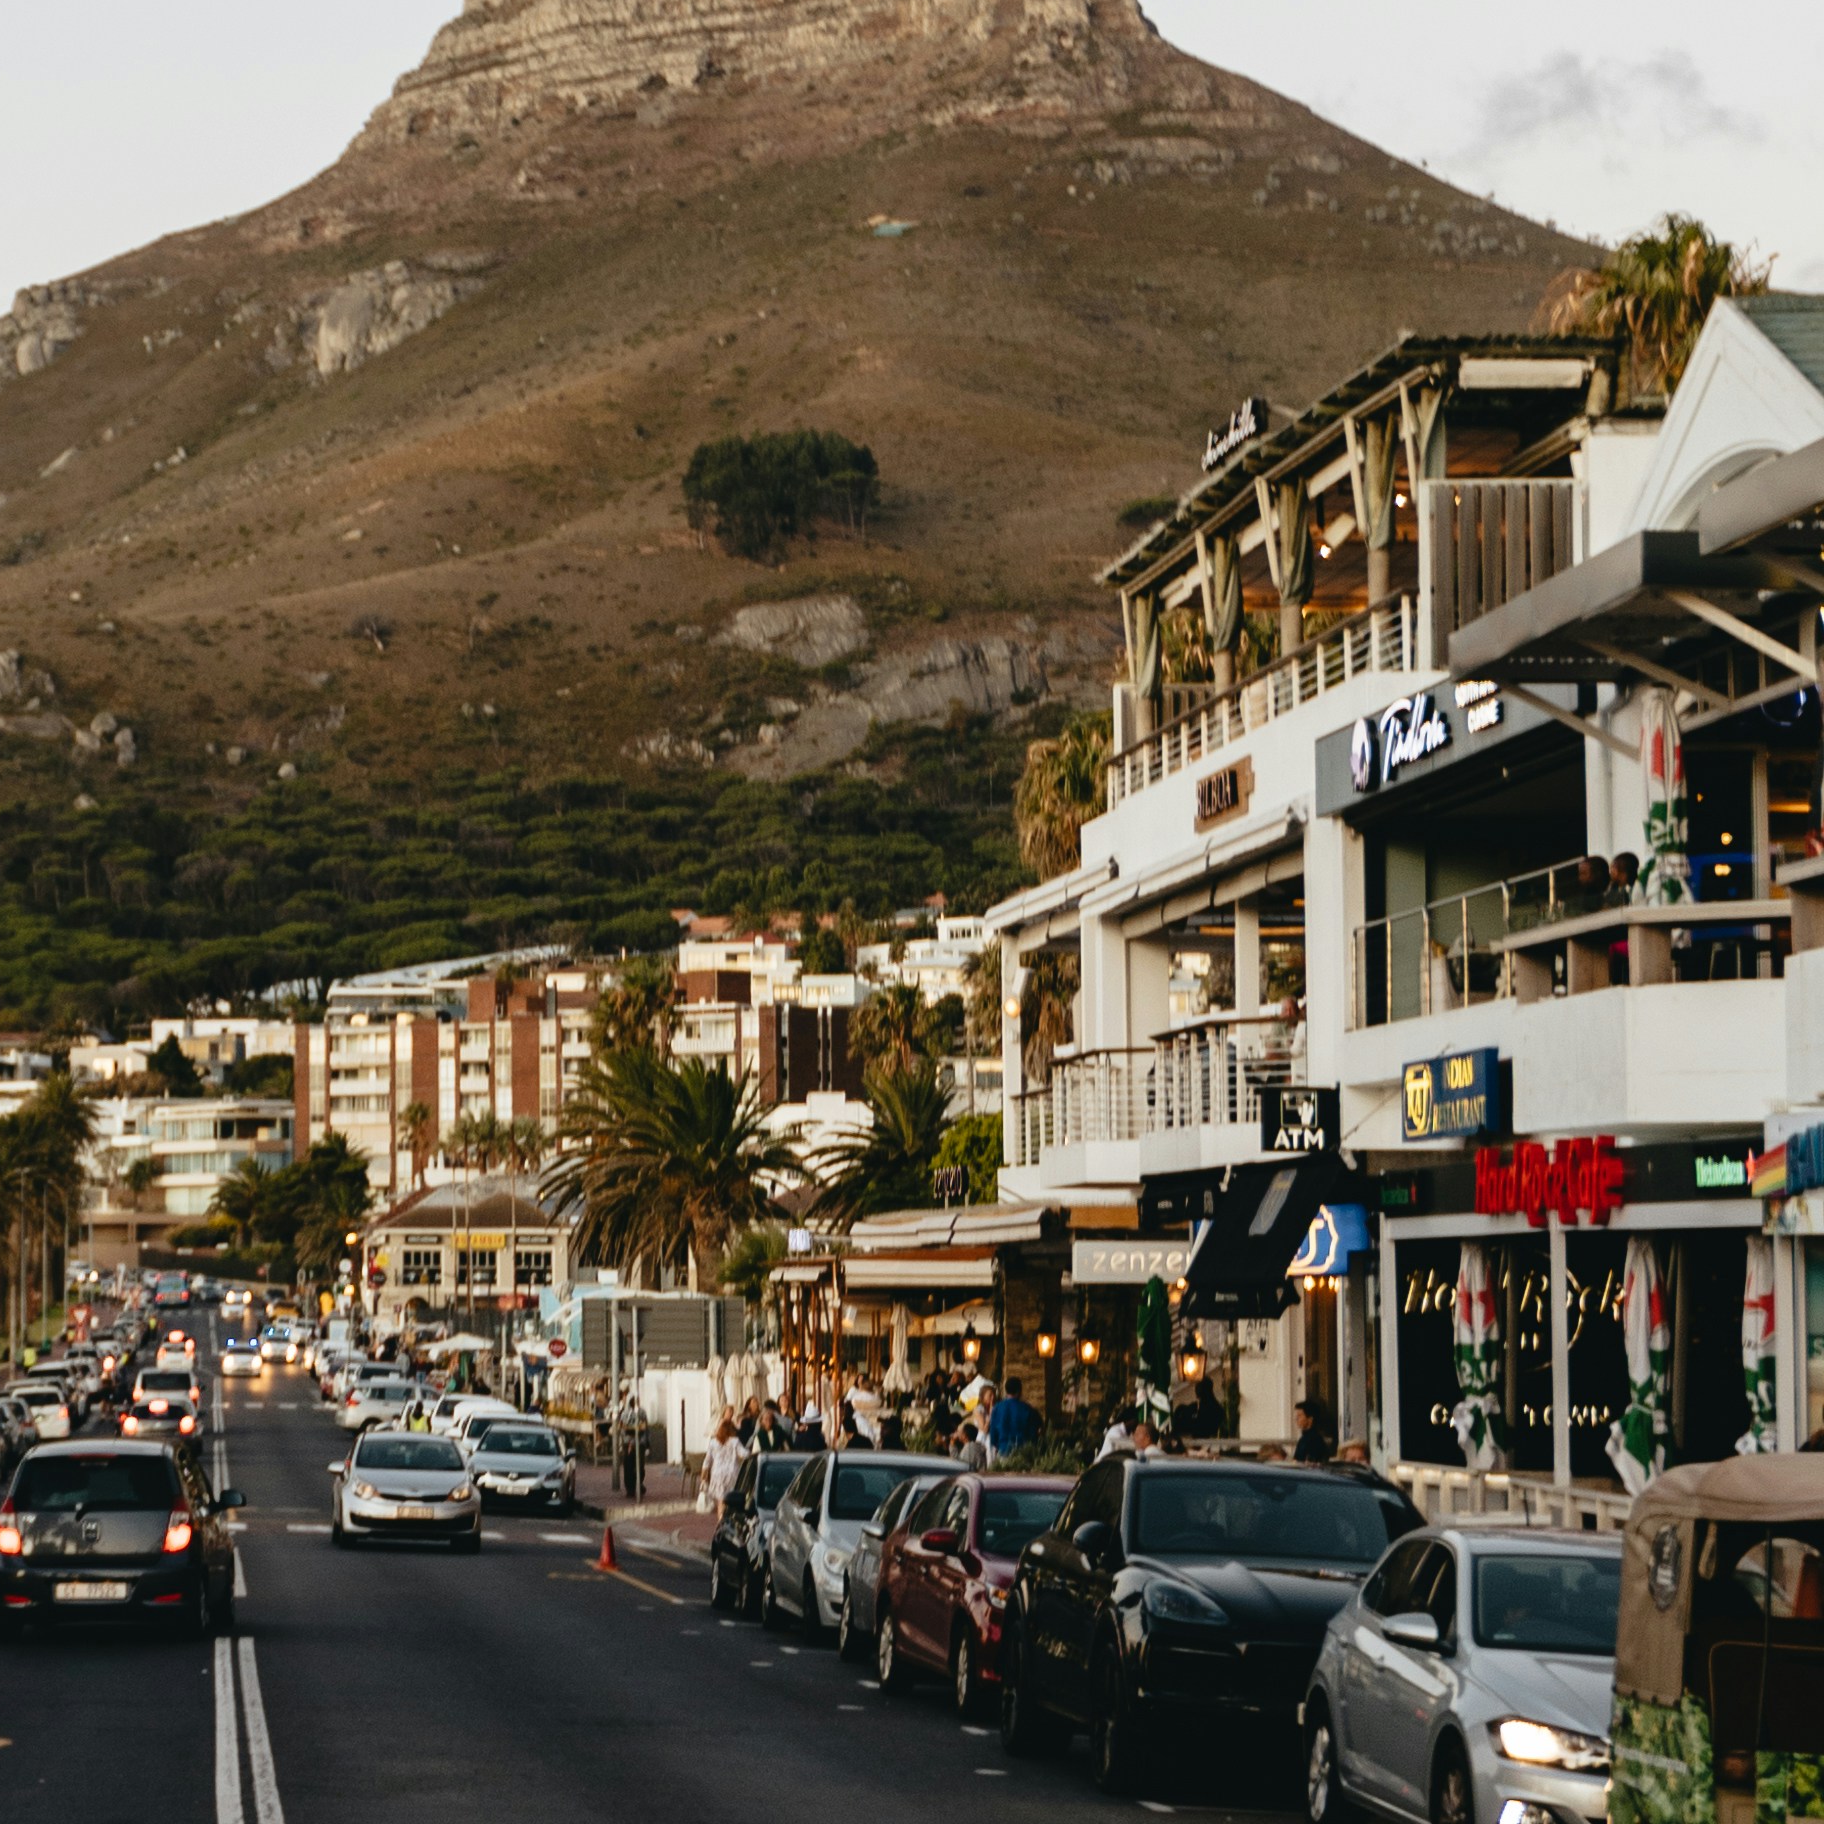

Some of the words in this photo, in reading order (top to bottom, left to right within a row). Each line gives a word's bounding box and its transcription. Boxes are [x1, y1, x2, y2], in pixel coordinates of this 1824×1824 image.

[1442, 1055, 1473, 1090] NDIAN
[1432, 1095, 1486, 1131] RESTAURANT
[1274, 1127, 1324, 1151] ATM
[1475, 1142, 1519, 1215] Hard
[1567, 1136, 1624, 1225] Cafe
[1695, 1157, 1745, 1187] Heineken
[1093, 1250, 1192, 1273] zenze
